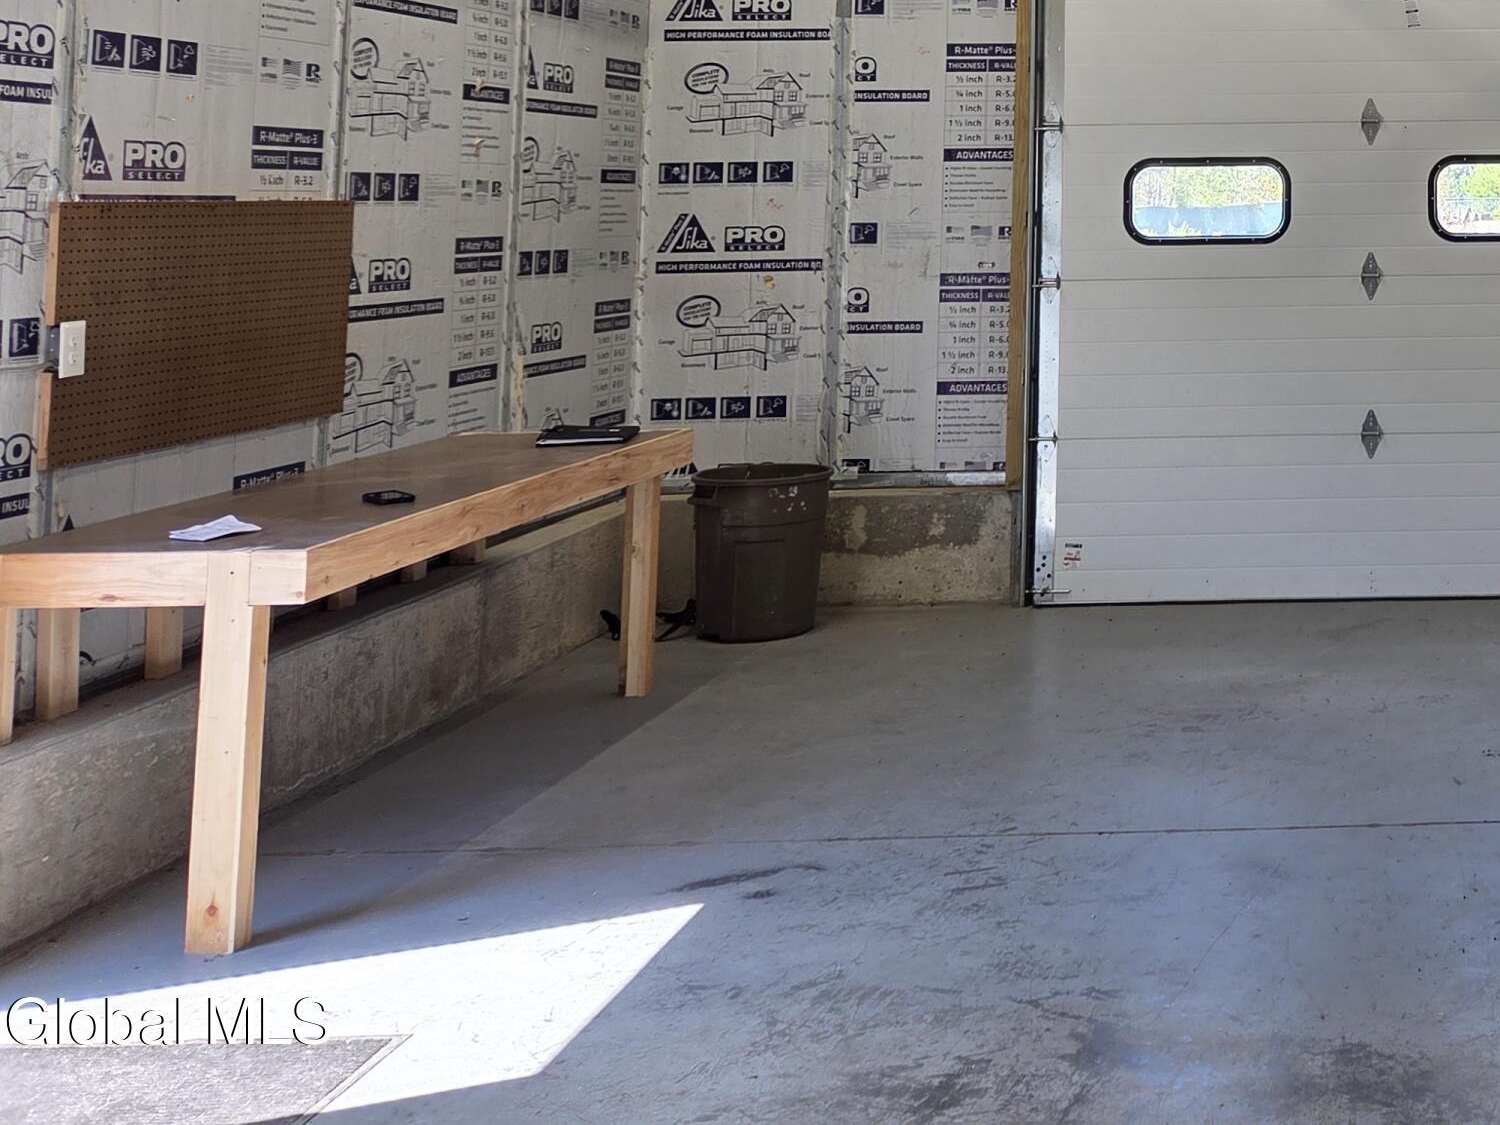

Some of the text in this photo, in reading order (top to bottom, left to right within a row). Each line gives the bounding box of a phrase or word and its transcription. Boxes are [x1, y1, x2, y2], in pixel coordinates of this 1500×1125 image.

[948, 61, 985, 70] THICKNESS
[124, 141, 186, 169] PRO
[956, 151, 1013, 159] ADVANTAGES
[128, 171, 181, 180] SELECT
[678, 228, 708, 249] Sika
[725, 226, 784, 244] PRO
[369, 259, 411, 281] PRO
[679, 263, 736, 271] PERFORMANCE
[762, 261, 810, 269] INSULATION
[372, 283, 409, 291] SELECT
[949, 383, 1008, 393] ADVANTAGES
